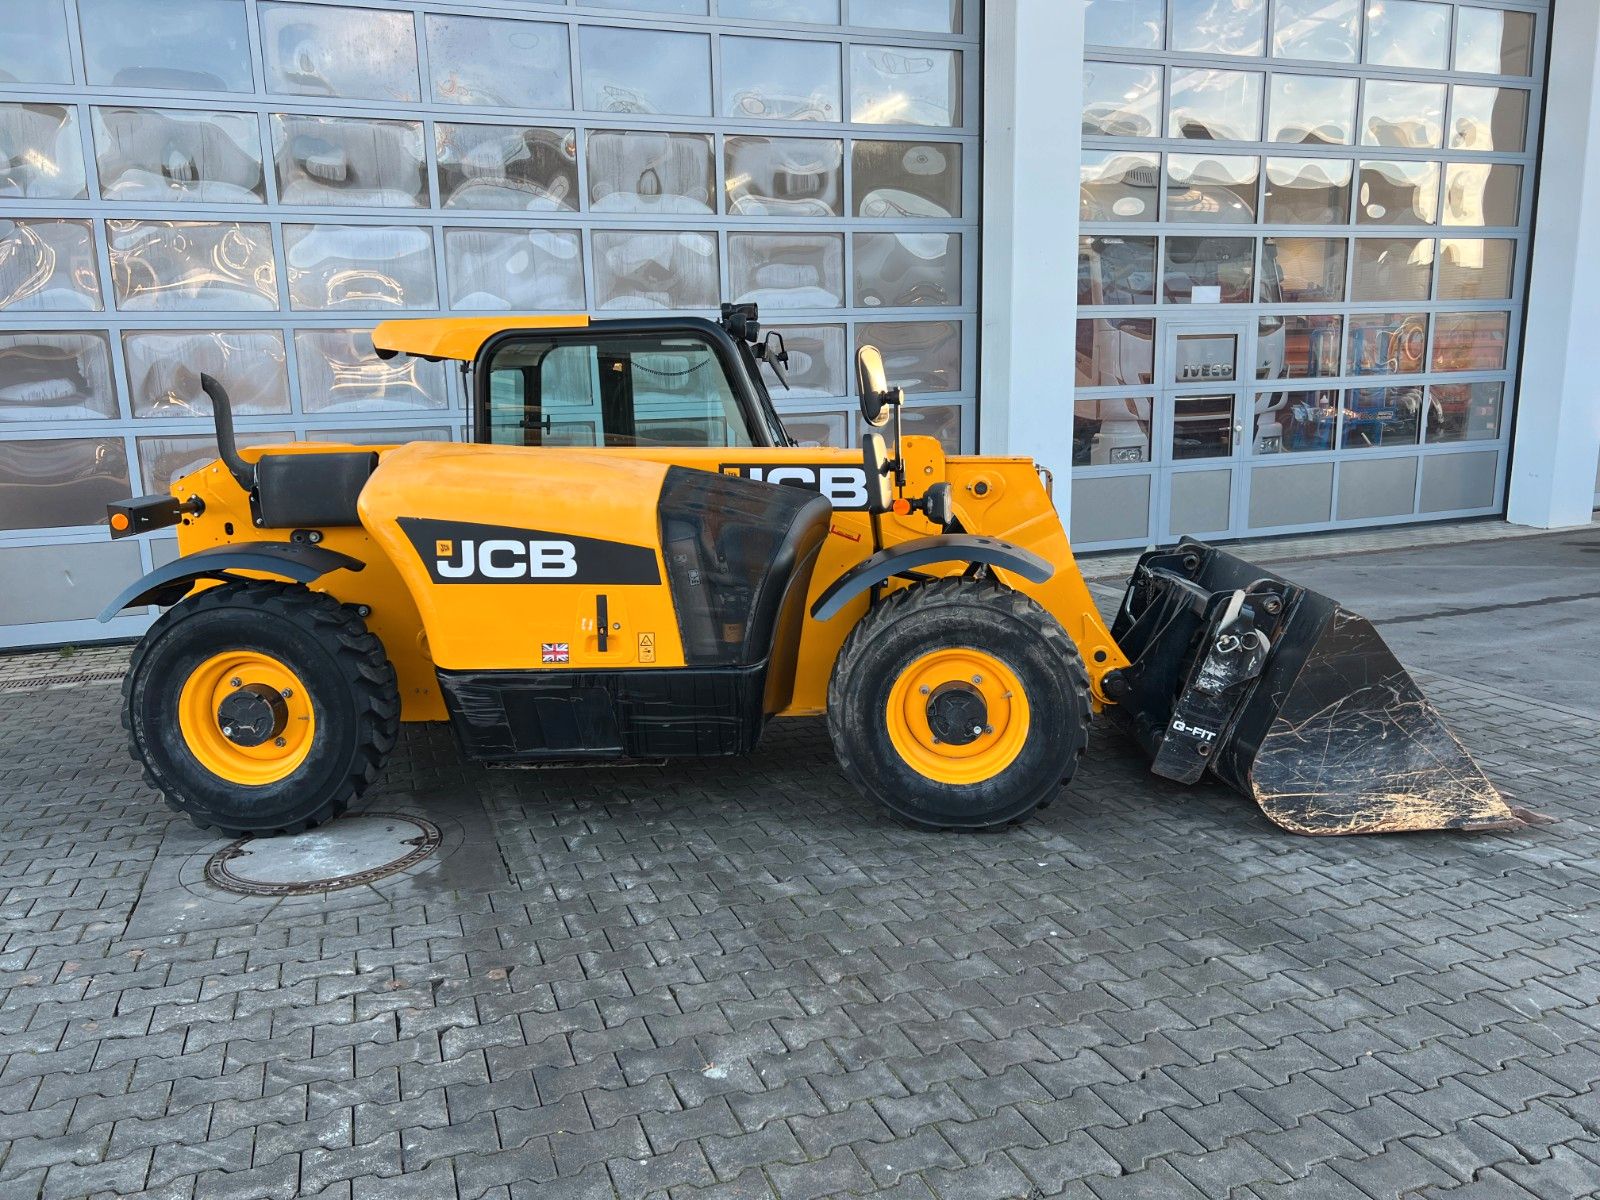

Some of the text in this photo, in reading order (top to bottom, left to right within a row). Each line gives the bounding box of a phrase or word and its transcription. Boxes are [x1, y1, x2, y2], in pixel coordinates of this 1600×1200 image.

[1183, 364, 1233, 377] IVECO
[436, 540, 578, 578] JCB
[1172, 720, 1217, 741] Q-FIT
